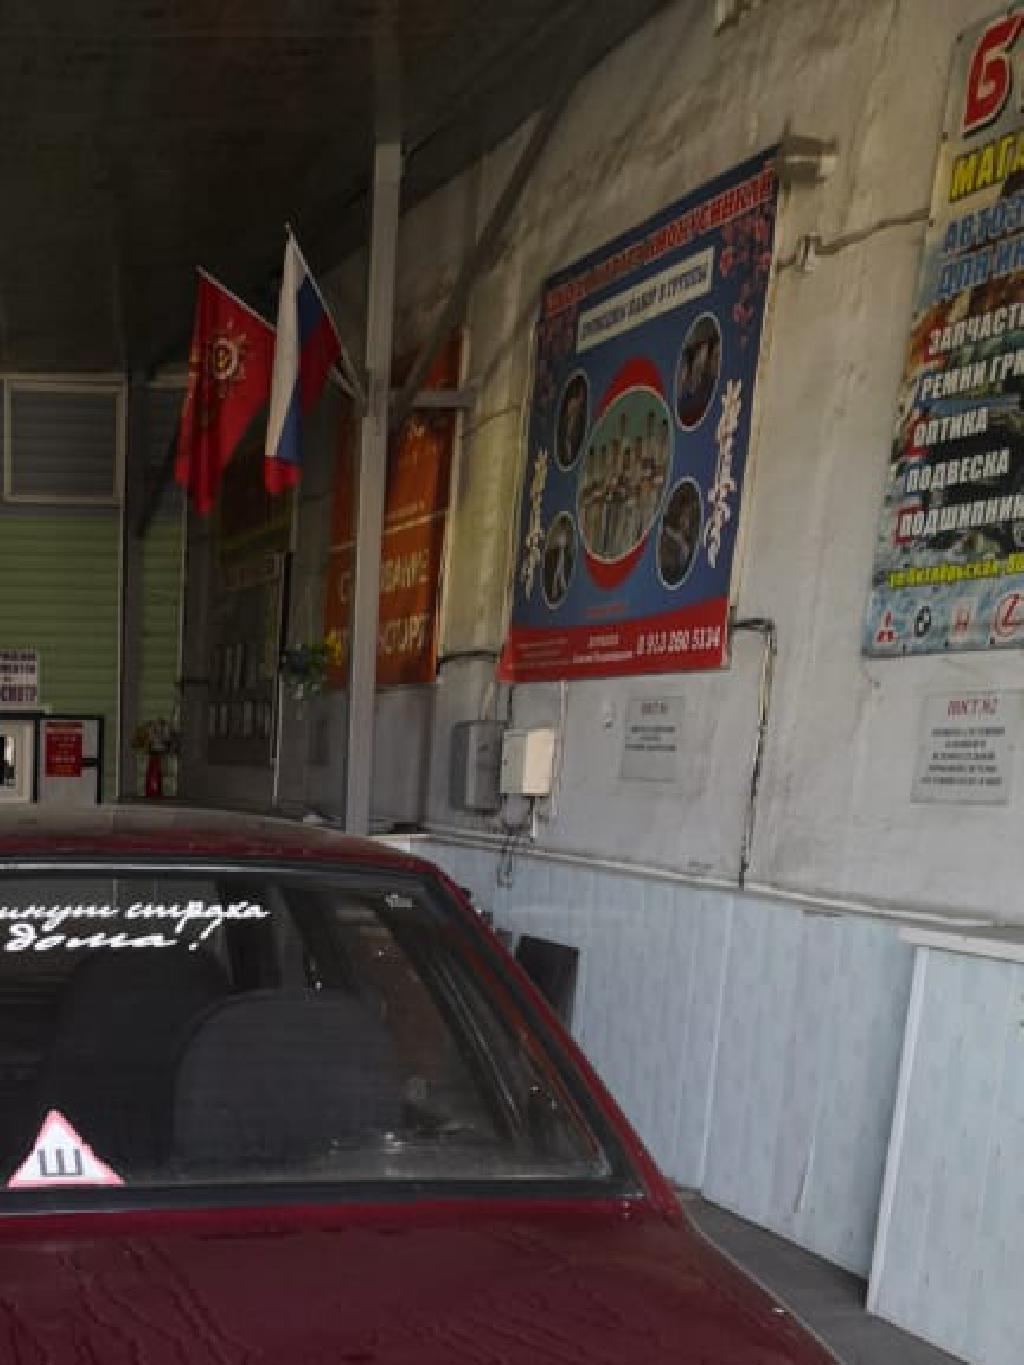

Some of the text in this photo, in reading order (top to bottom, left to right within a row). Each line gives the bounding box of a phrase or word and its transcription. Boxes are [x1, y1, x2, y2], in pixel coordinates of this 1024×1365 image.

[914, 406, 988, 446] ОПТИКА
[907, 447, 1009, 492] ПОДВЕСКА
[124, 899, 271, 934] страха
[36, 1148, 85, 1178] Ш
